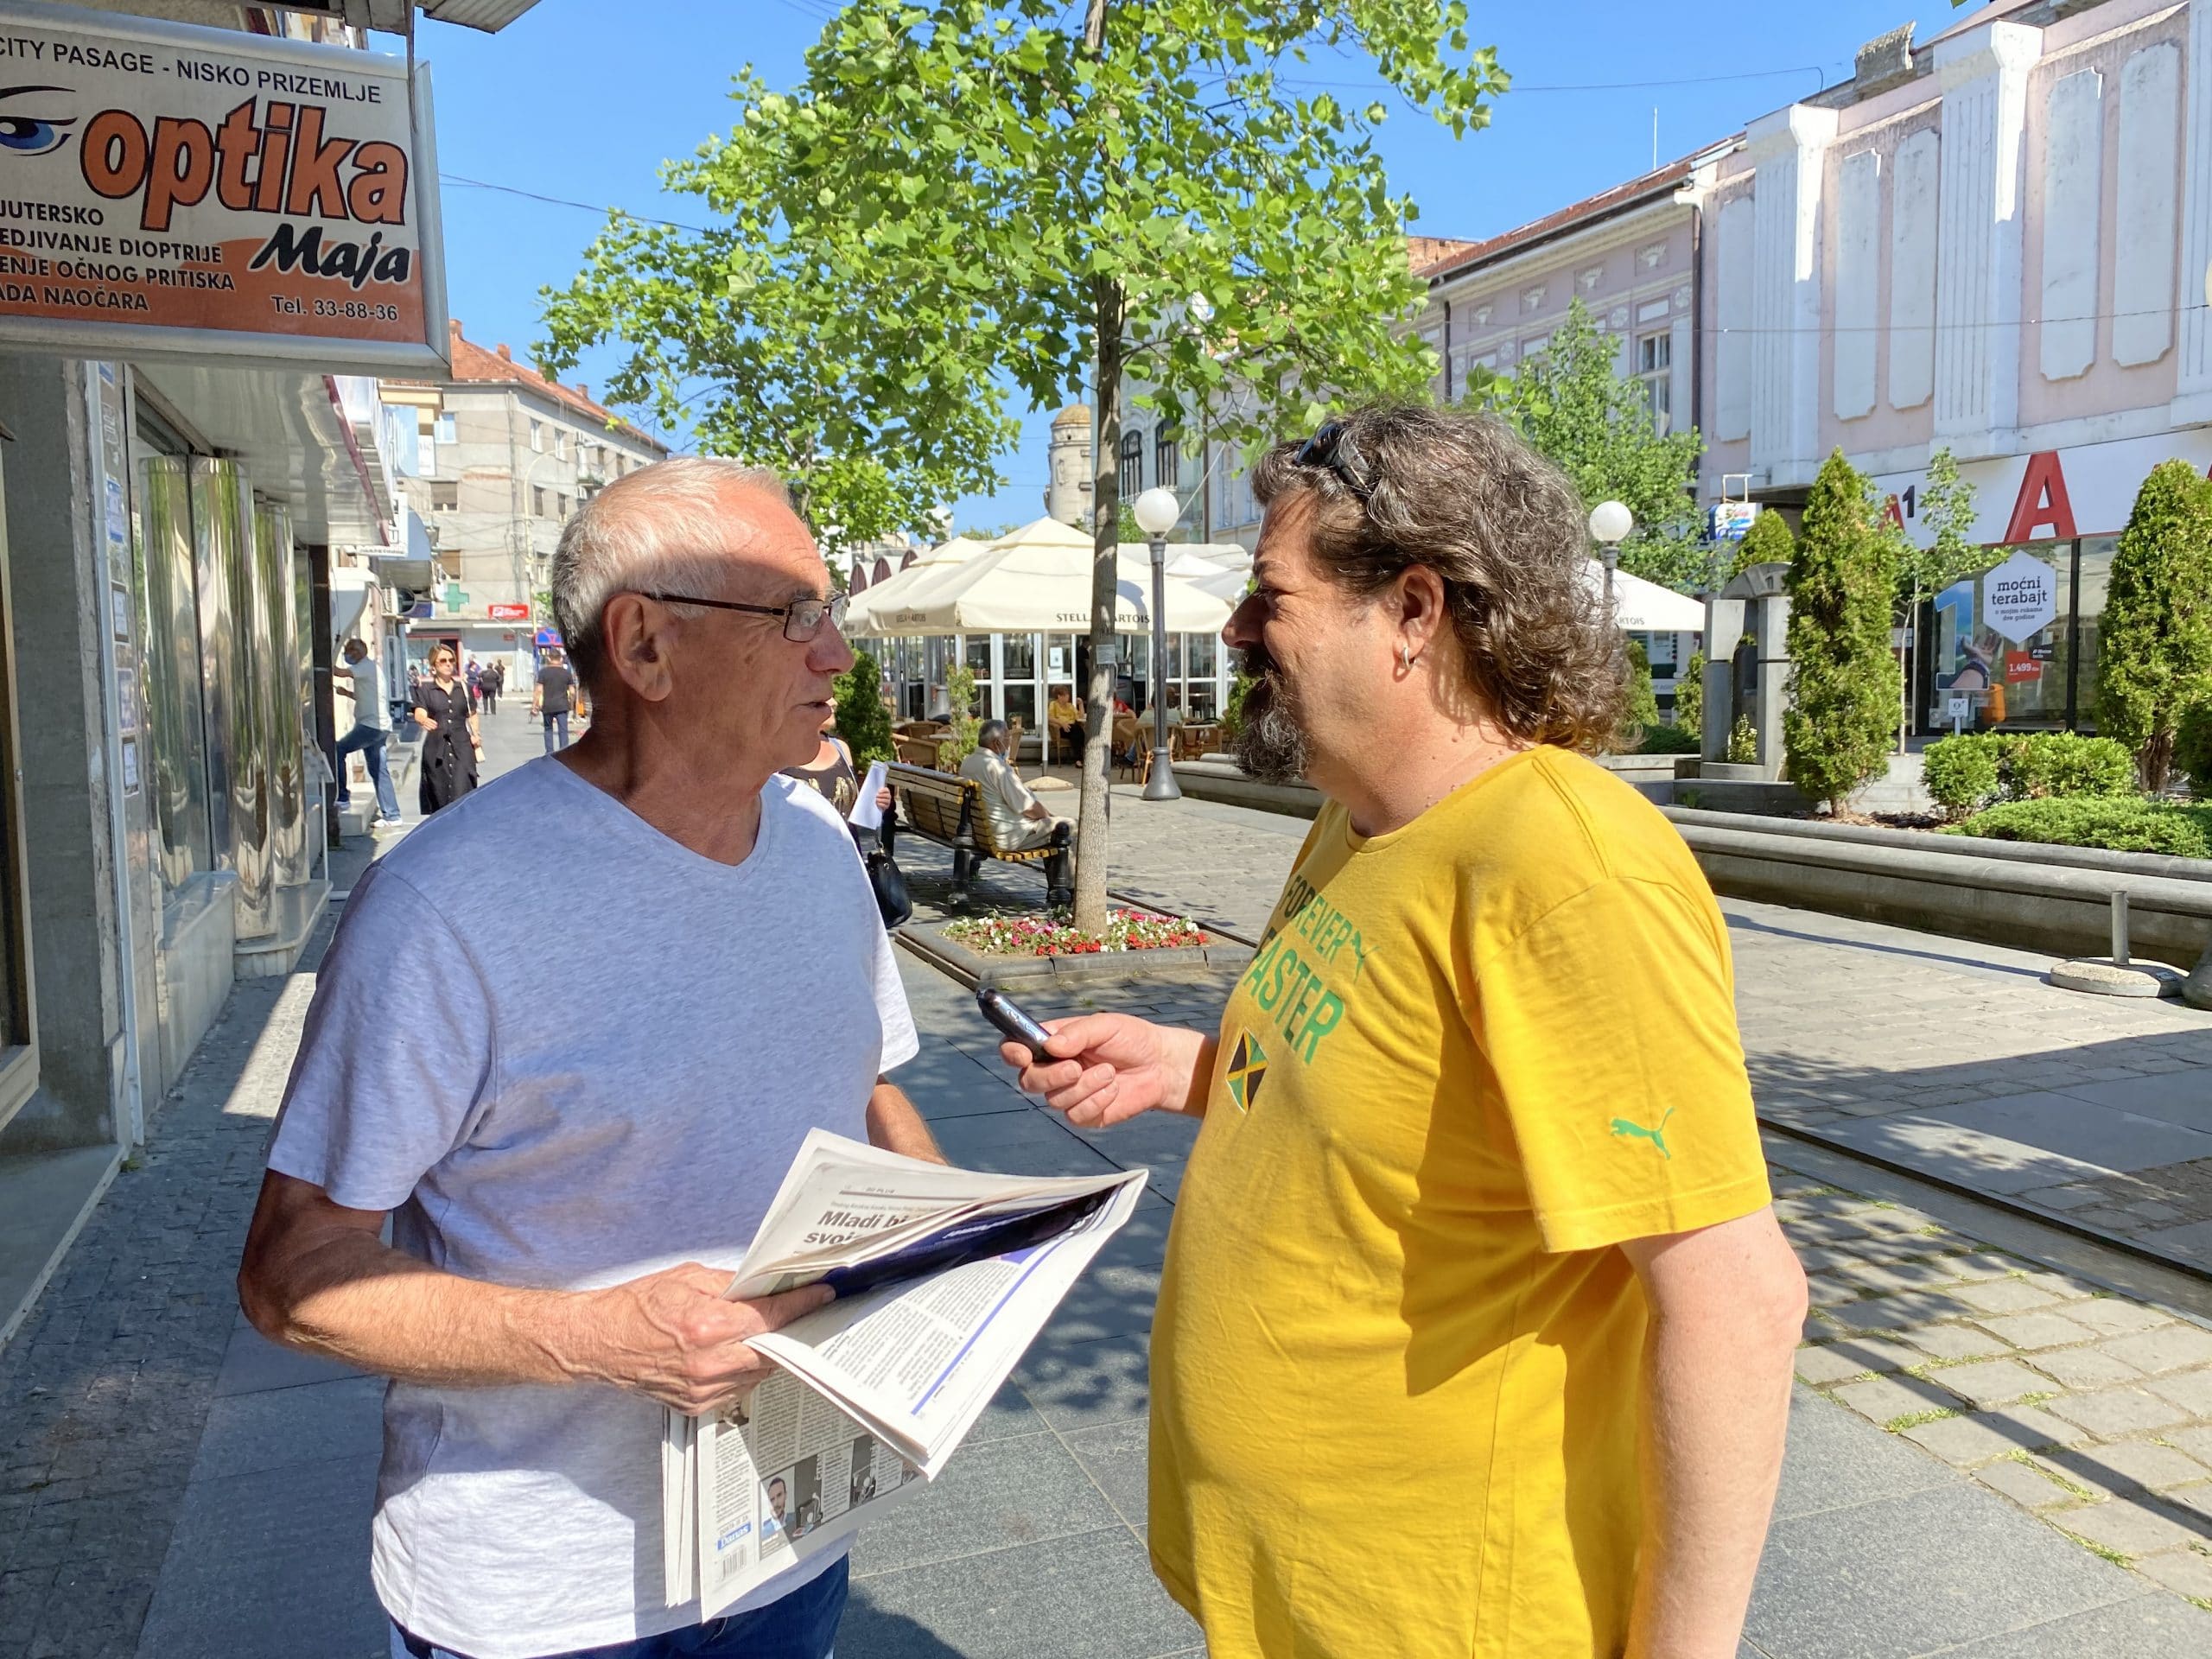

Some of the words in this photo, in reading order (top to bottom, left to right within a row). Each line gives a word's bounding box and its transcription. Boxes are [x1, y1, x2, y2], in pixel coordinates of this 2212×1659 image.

[53, 43, 155, 74] PASAGE
[176, 60, 251, 86] NISKO
[258, 71, 382, 104] PRIZEMLJE
[80, 95, 409, 232] optika
[0, 228, 112, 254] EDJIVANJE
[119, 238, 222, 264] DIOPTRIJE
[249, 223, 410, 289] Maja
[56, 257, 138, 282] OČNOG
[145, 268, 236, 291] PRITISKA
[44, 286, 149, 311] NAOČARA
[271, 296, 308, 315] Tel.
[315, 299, 398, 321] 33-88-36
[1997, 576, 2041, 592] moćni
[1992, 589, 2048, 606] terabajt
[1056, 613, 1091, 622] STELL
[1115, 614, 1150, 623] RTOIS
[2009, 663, 2032, 672] 1.499
[1281, 874, 1354, 965] FOREVER
[817, 1211, 885, 1229] Mladi
